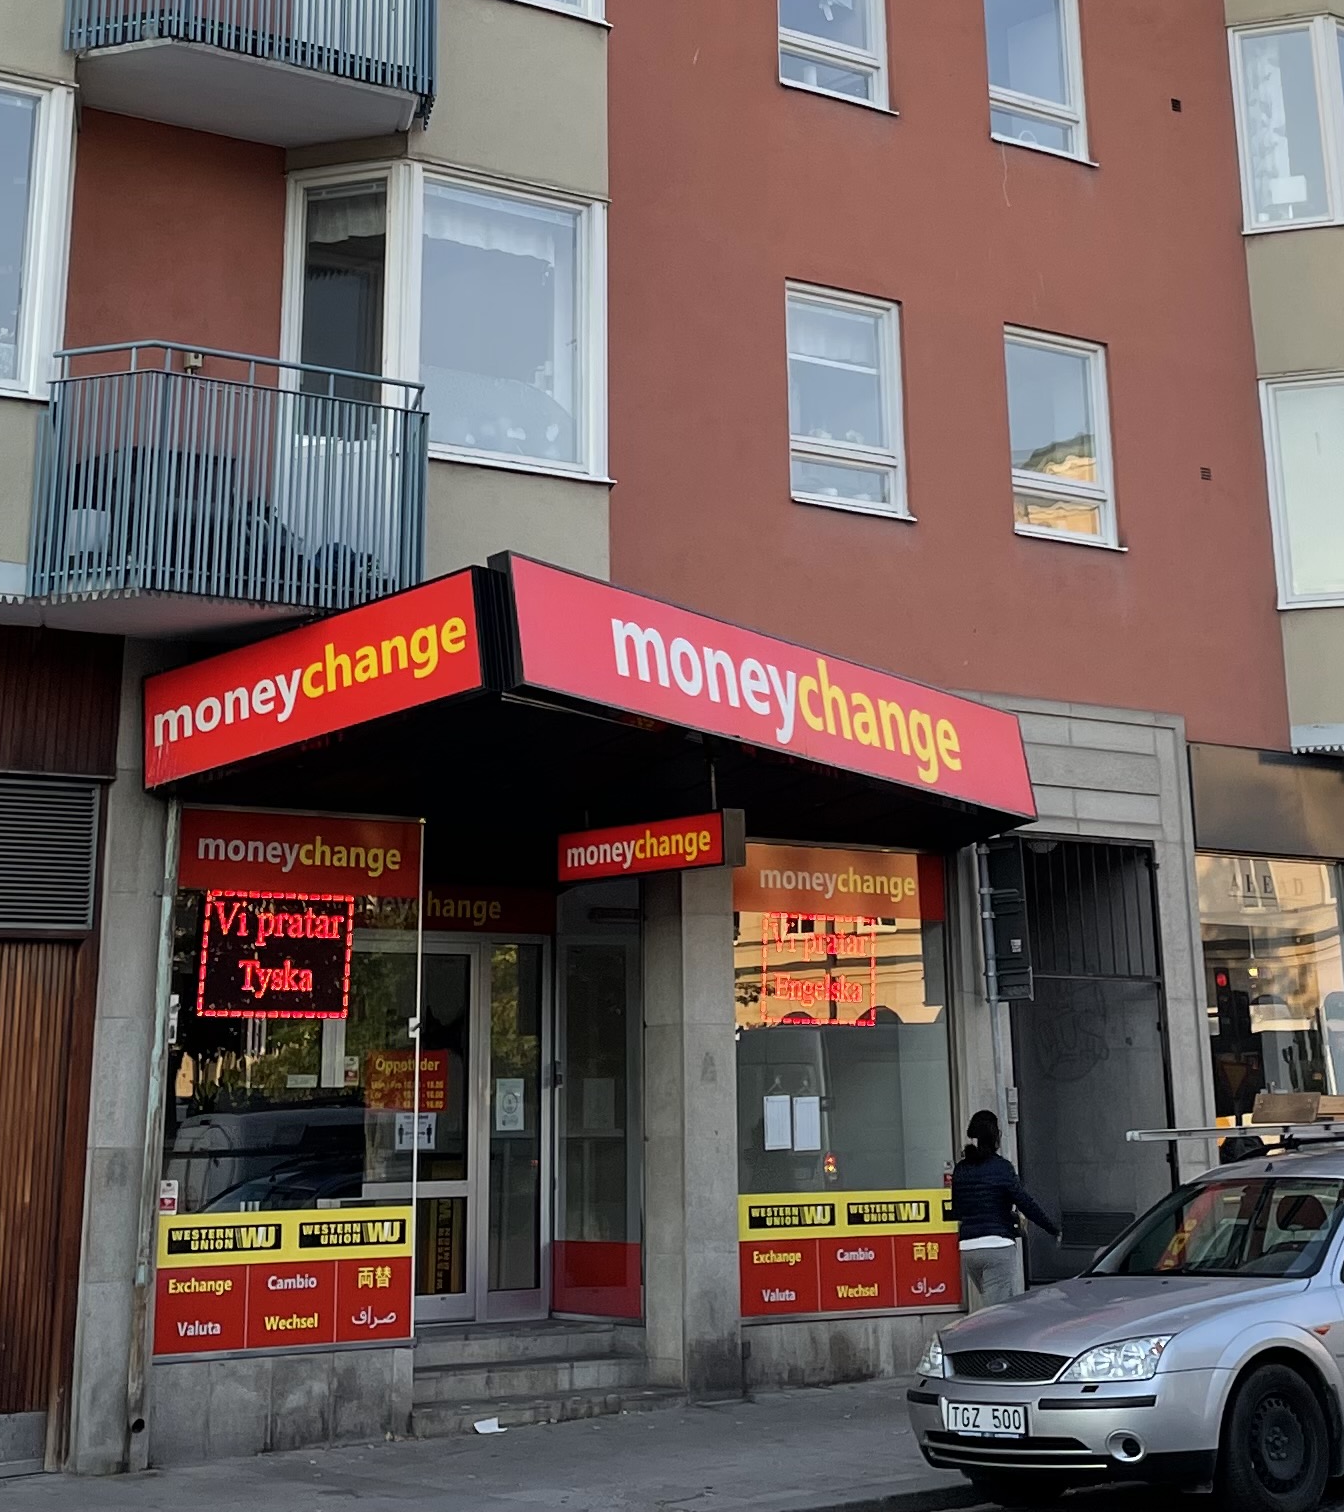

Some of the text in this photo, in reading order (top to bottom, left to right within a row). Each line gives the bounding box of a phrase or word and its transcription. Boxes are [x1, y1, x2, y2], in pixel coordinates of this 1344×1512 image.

[153, 617, 467, 747] moneychange
[611, 618, 962, 784] moneychange
[198, 836, 401, 877] moneychange
[567, 829, 711, 869] moneychange
[760, 866, 916, 902] moneychange
[213, 900, 345, 947] Vi pratar
[802, 929, 869, 962] pratar
[239, 959, 313, 999] Tyska
[773, 972, 863, 1007] Engelska
[750, 1207, 799, 1217] WESTERN
[800, 1205, 832, 1225] WU
[849, 1204, 895, 1214] WESTERN
[863, 1212, 895, 1222] UNION
[896, 1203, 927, 1221] WU
[302, 1223, 361, 1235] WESTERN
[766, 1216, 799, 1226] UNION
[171, 1228, 234, 1241] WESTERN
[235, 1226, 276, 1248] WU
[320, 1233, 360, 1244] UNION
[362, 1221, 401, 1242] WU
[191, 1239, 233, 1250] UNION
[753, 1251, 801, 1265] Exchange
[836, 1248, 875, 1261] Cambio
[168, 1277, 232, 1295] Exchange
[267, 1274, 317, 1290] Cambio
[357, 1267, 391, 1289] 両替
[762, 1288, 796, 1302] Valuta
[837, 1284, 879, 1298] Wechsel
[177, 1321, 221, 1336] Valuta
[264, 1312, 319, 1331] Wechsel
[952, 1406, 1022, 1430] TGZ 500
